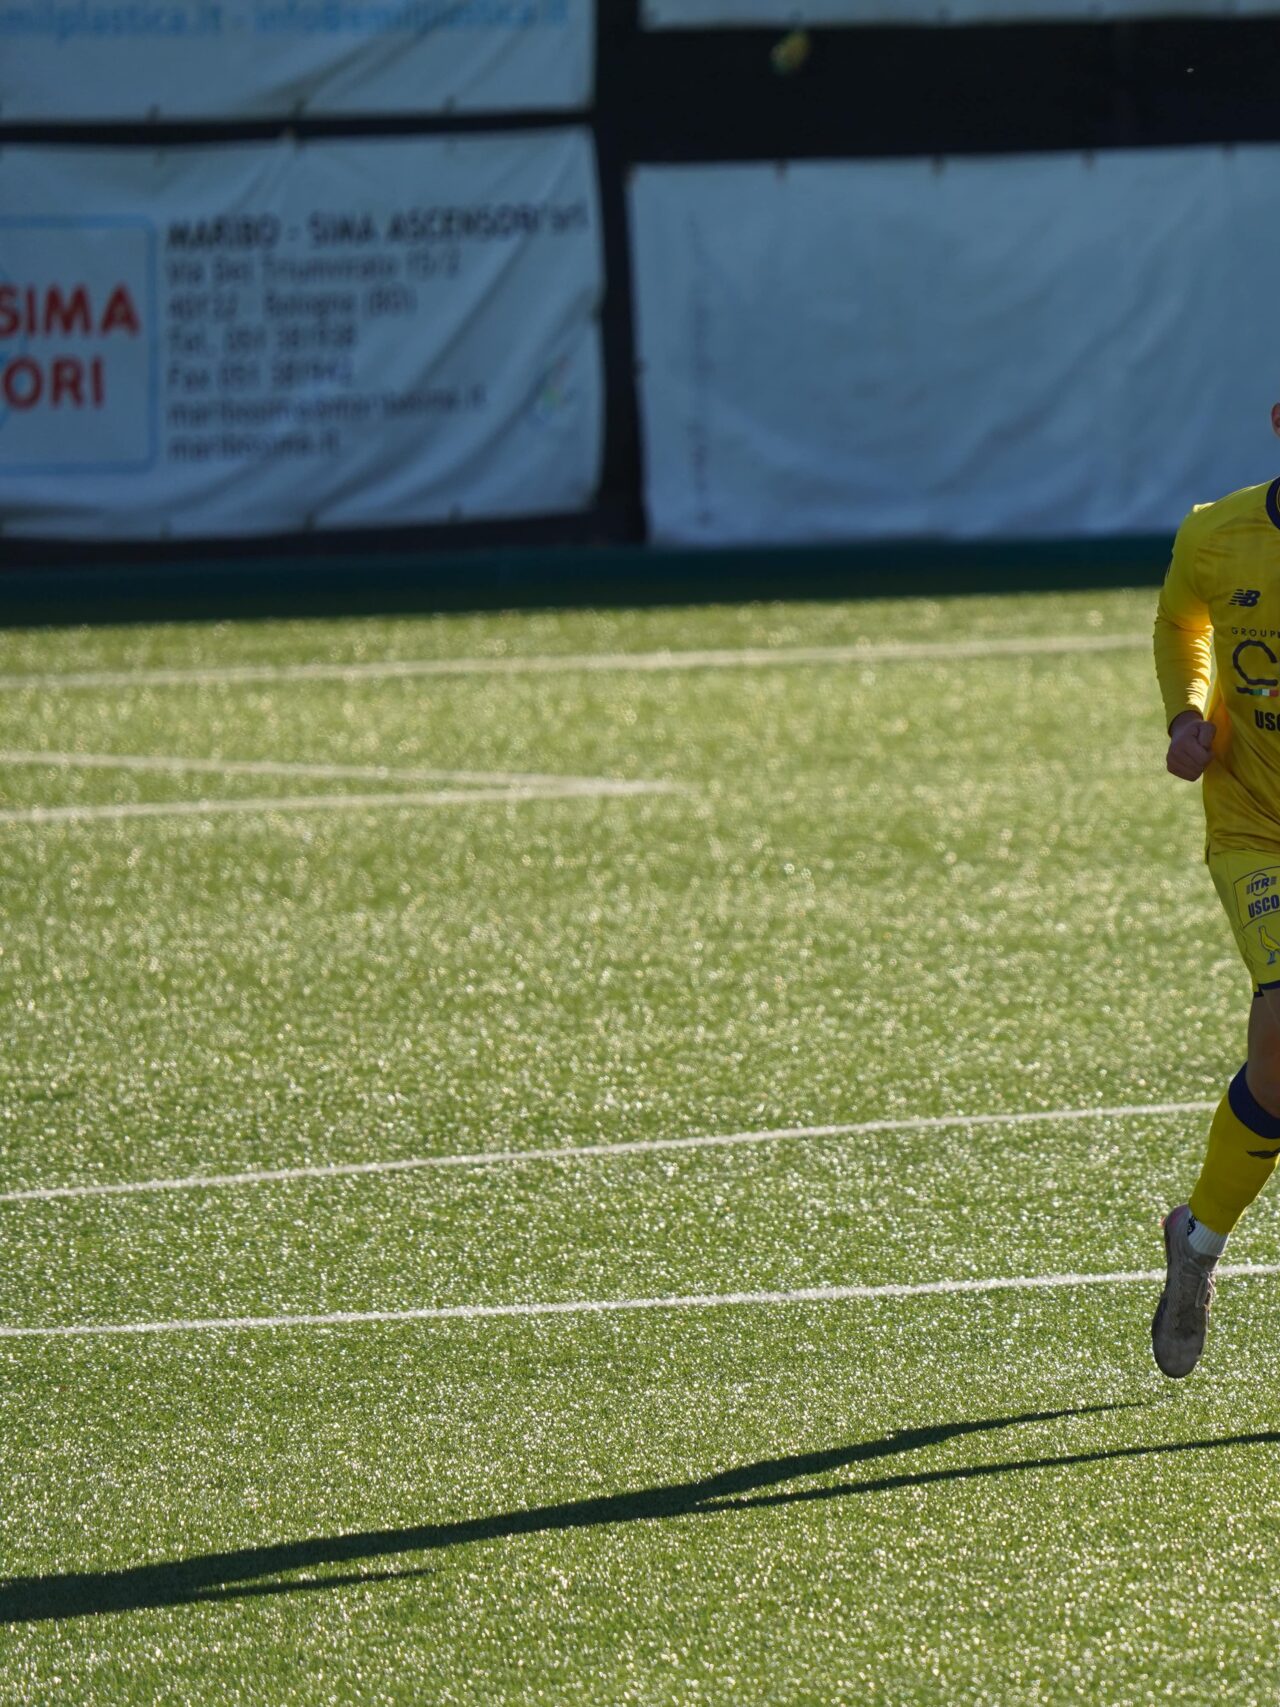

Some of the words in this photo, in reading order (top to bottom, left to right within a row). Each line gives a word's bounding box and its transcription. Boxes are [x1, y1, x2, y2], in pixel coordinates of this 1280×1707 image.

[308, 210, 377, 251] SIMA
[0, 281, 141, 338] SIMA
[4, 355, 105, 411] ORI
[1232, 627, 1276, 638] GROUP
[1248, 894, 1280, 918] USCO
